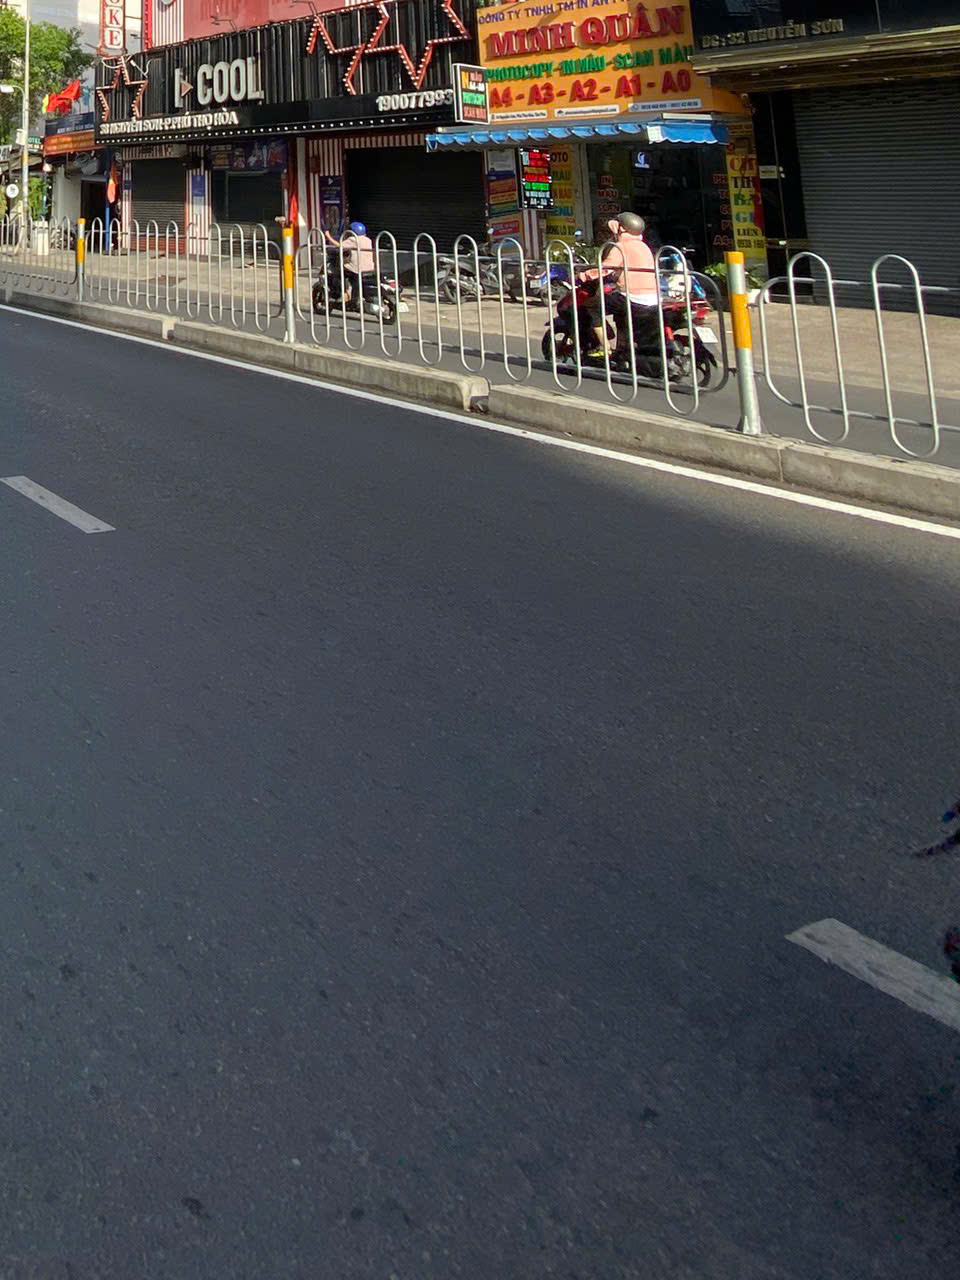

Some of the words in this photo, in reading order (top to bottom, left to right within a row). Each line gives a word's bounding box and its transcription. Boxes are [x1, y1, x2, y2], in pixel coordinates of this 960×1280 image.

[507, 9, 521, 20] TY
[524, 4, 554, 17] TNHH
[488, 20, 577, 58] MINH
[580, 2, 686, 44] QUÂN
[615, 49, 654, 68] SCAN
[196, 55, 265, 106] COOL
[490, 86, 513, 108] A4
[527, 82, 555, 106] A3
[569, 77, 599, 103] A2
[614, 73, 642, 99] A1
